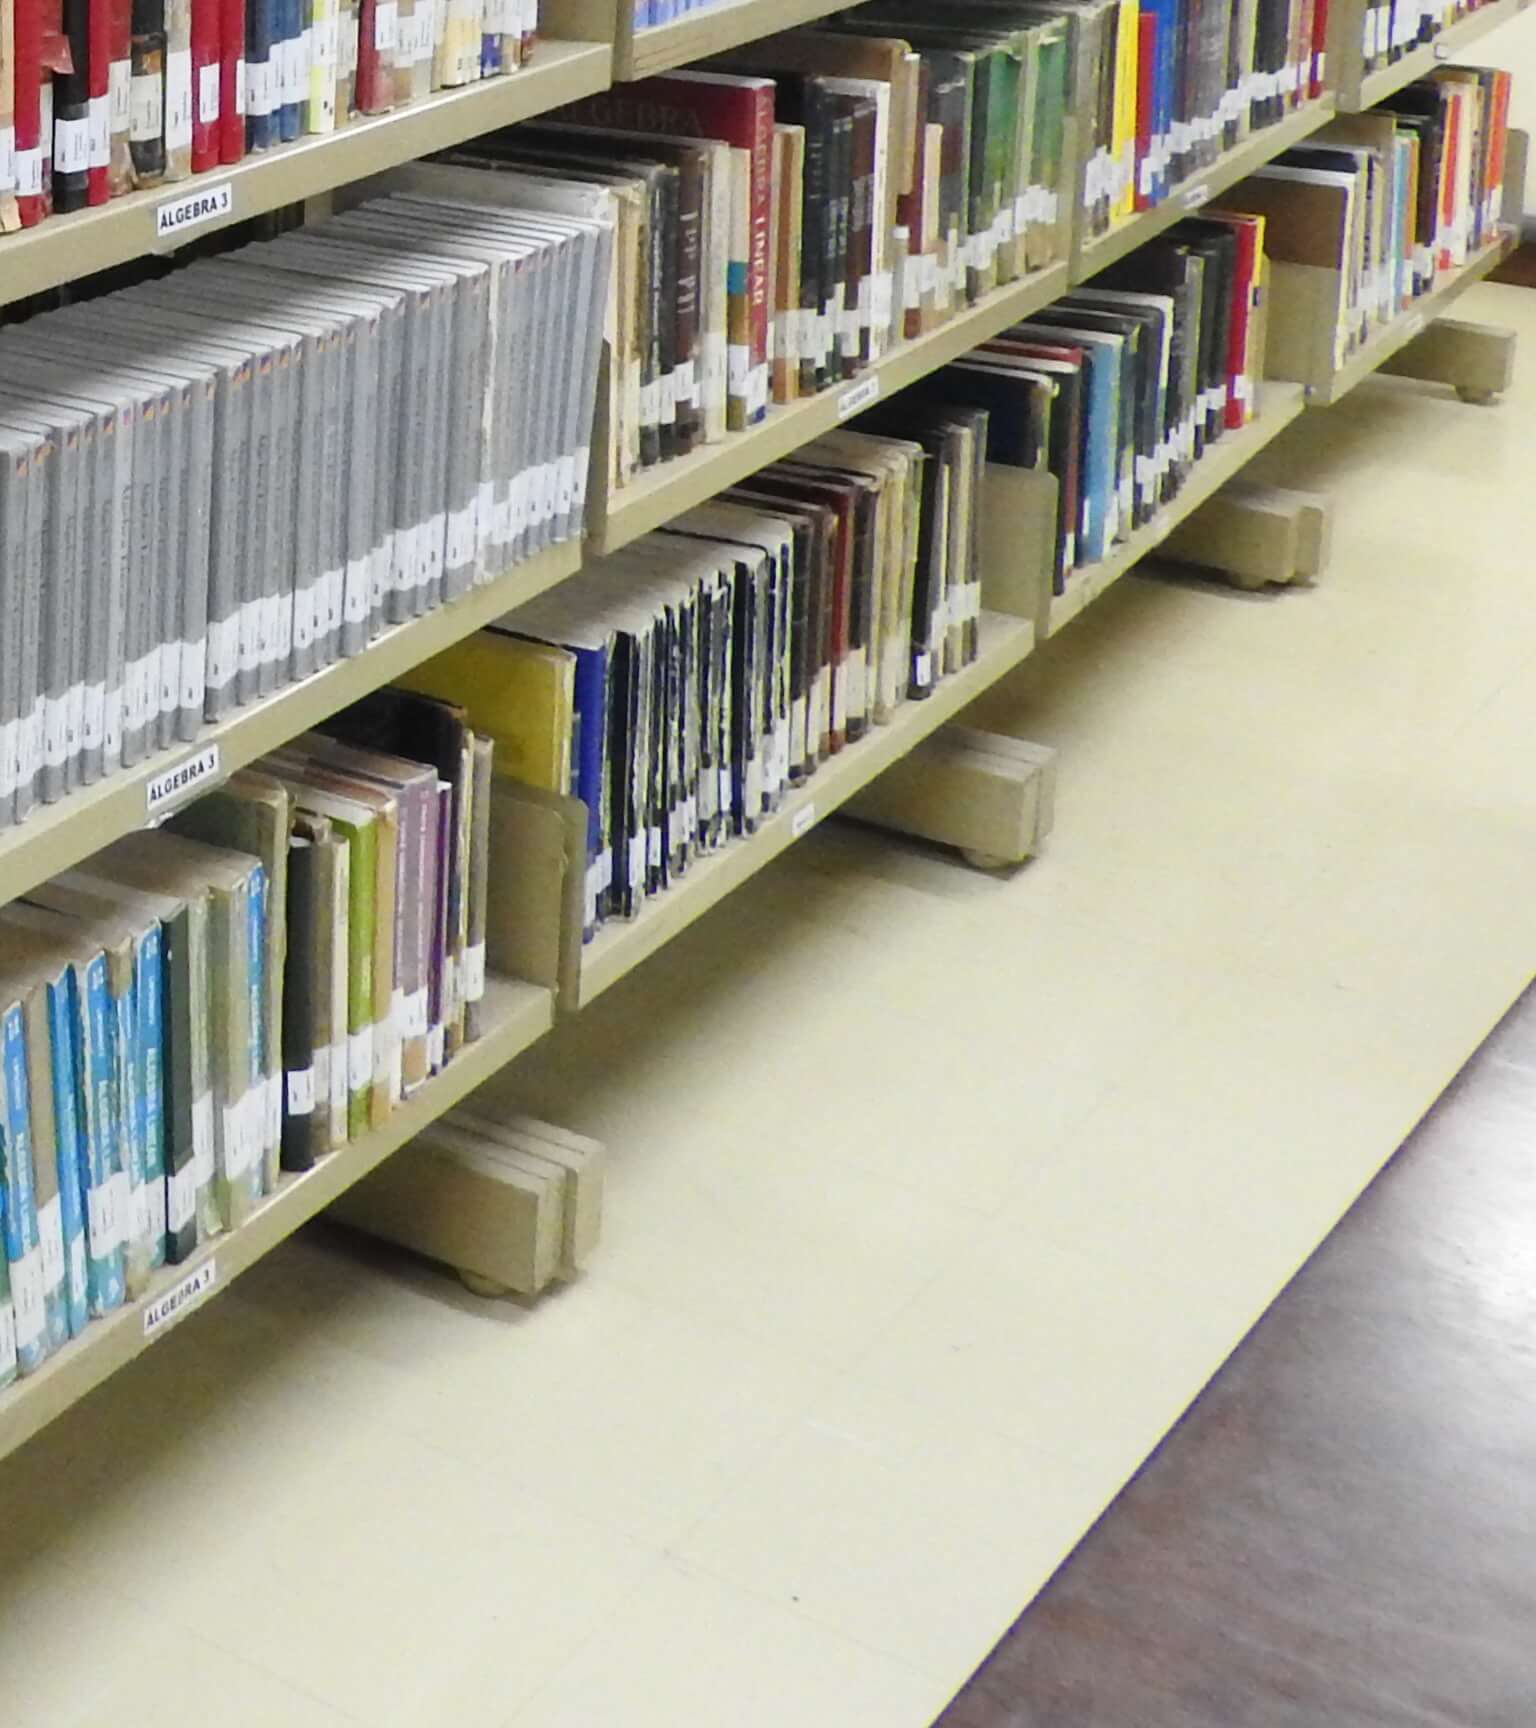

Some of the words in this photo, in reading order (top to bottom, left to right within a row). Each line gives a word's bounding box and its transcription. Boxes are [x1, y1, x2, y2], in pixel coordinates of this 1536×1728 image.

[220, 192, 229, 209] 3
[208, 755, 217, 770] 3
[203, 1269, 211, 1282] 3
